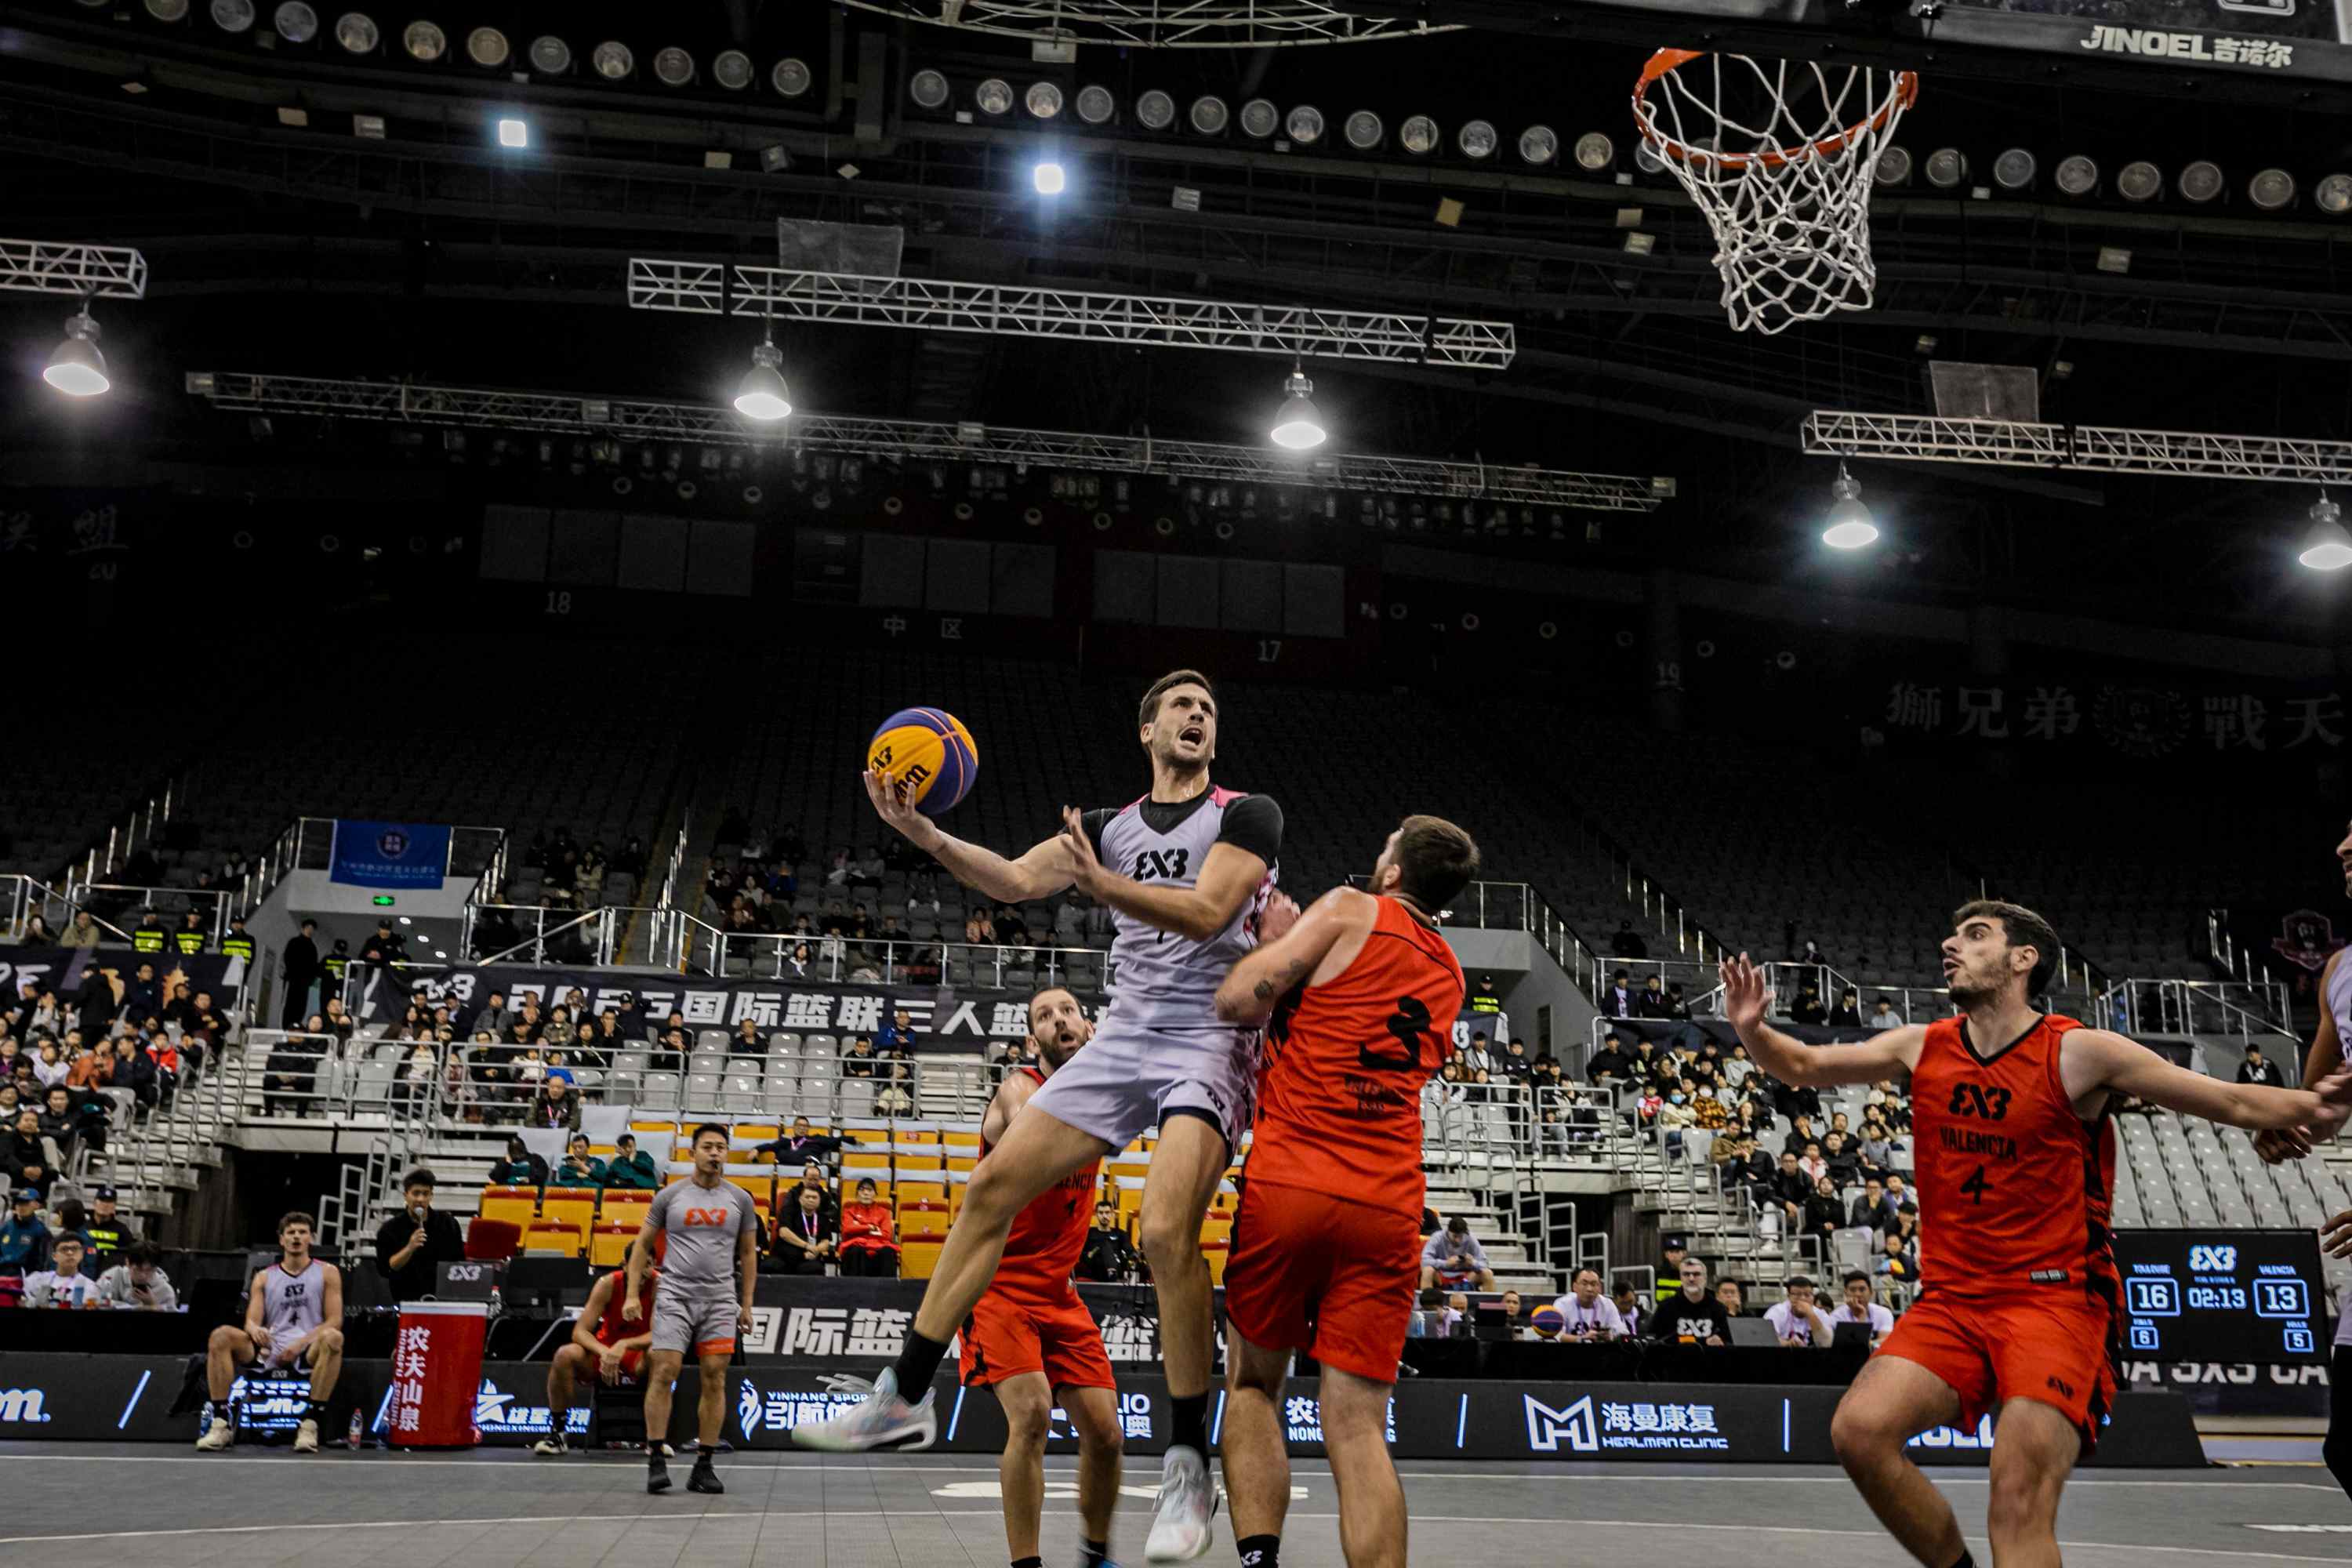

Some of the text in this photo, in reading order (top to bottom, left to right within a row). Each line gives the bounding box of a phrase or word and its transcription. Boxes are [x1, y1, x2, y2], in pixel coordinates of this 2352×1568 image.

[2080, 24, 2293, 68] JINOEL 吉诺尔
[545, 590, 571, 615] 18
[1258, 640, 1282, 664] 17
[1940, 1127, 2019, 1162] VALENCIA
[1961, 1165, 1994, 1205] 4
[2137, 1284, 2169, 1308] 16
[2188, 1287, 2246, 1309] 02:13
[2265, 1286, 2298, 1310] 13
[2139, 1330, 2151, 1345] 6
[2293, 1334, 2304, 1348] 5
[398, 1327, 430, 1432] 农夫山泉
[767, 1392, 828, 1402] YINHANG
[1602, 1402, 1719, 1433] 海曼康复
[1602, 1436, 1729, 1450] HEALMAN CLINIC
